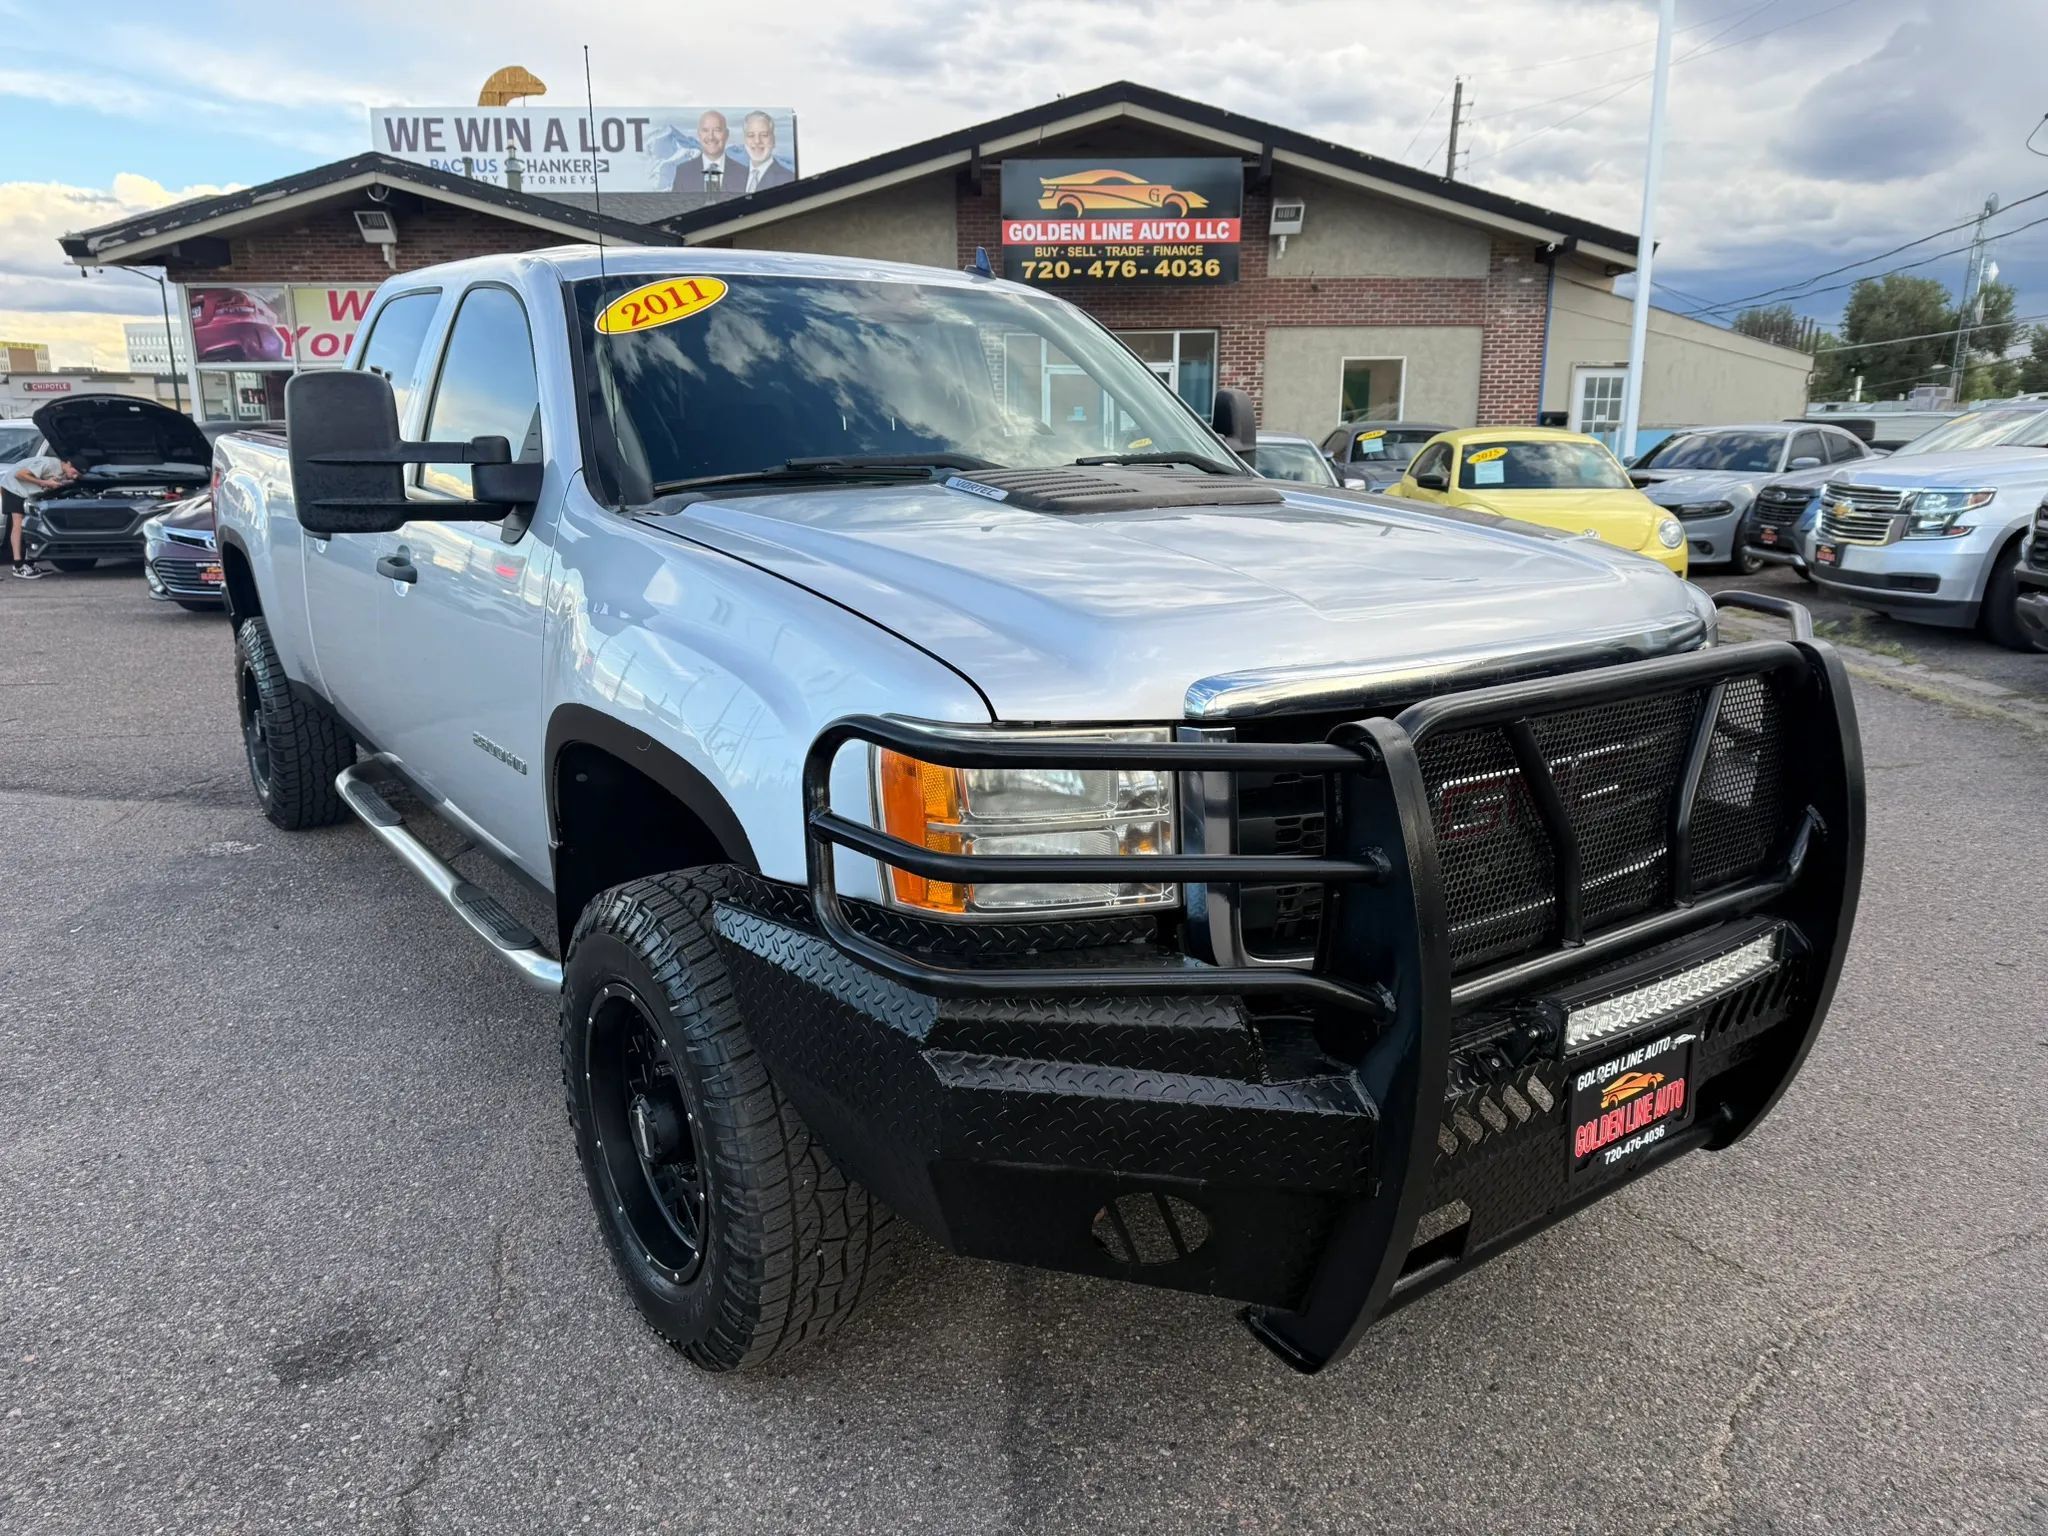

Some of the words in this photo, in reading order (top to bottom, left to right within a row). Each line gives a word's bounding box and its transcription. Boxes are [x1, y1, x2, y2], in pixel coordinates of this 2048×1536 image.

[384, 117, 446, 153] WE
[454, 117, 532, 153] WIN
[543, 117, 569, 153] A
[578, 117, 650, 153] LOT
[505, 158, 593, 173] CHANKER
[1148, 188, 1160, 202] G
[1008, 222, 1086, 241] GOLDEN
[1090, 222, 1136, 241] LINE
[1138, 221, 1191, 241] AUTO
[1195, 221, 1231, 240] LLC
[1034, 247, 1058, 257] BUY
[1067, 247, 1097, 257] SELL
[1105, 246, 1144, 257] TRADE
[1153, 245, 1204, 256] FINANCE
[620, 279, 710, 327] 2011
[956, 480, 998, 496] VORTEC
[1577, 1060, 1620, 1092] GOLDEN
[1620, 1047, 1645, 1071] LINE
[1645, 1036, 1671, 1061] AUTO
[1574, 1105, 1626, 1158] GOLDEN
[1625, 1091, 1654, 1134] LINE
[1653, 1077, 1686, 1120] AUTO
[1604, 1124, 1666, 1165] 720-476-4036
